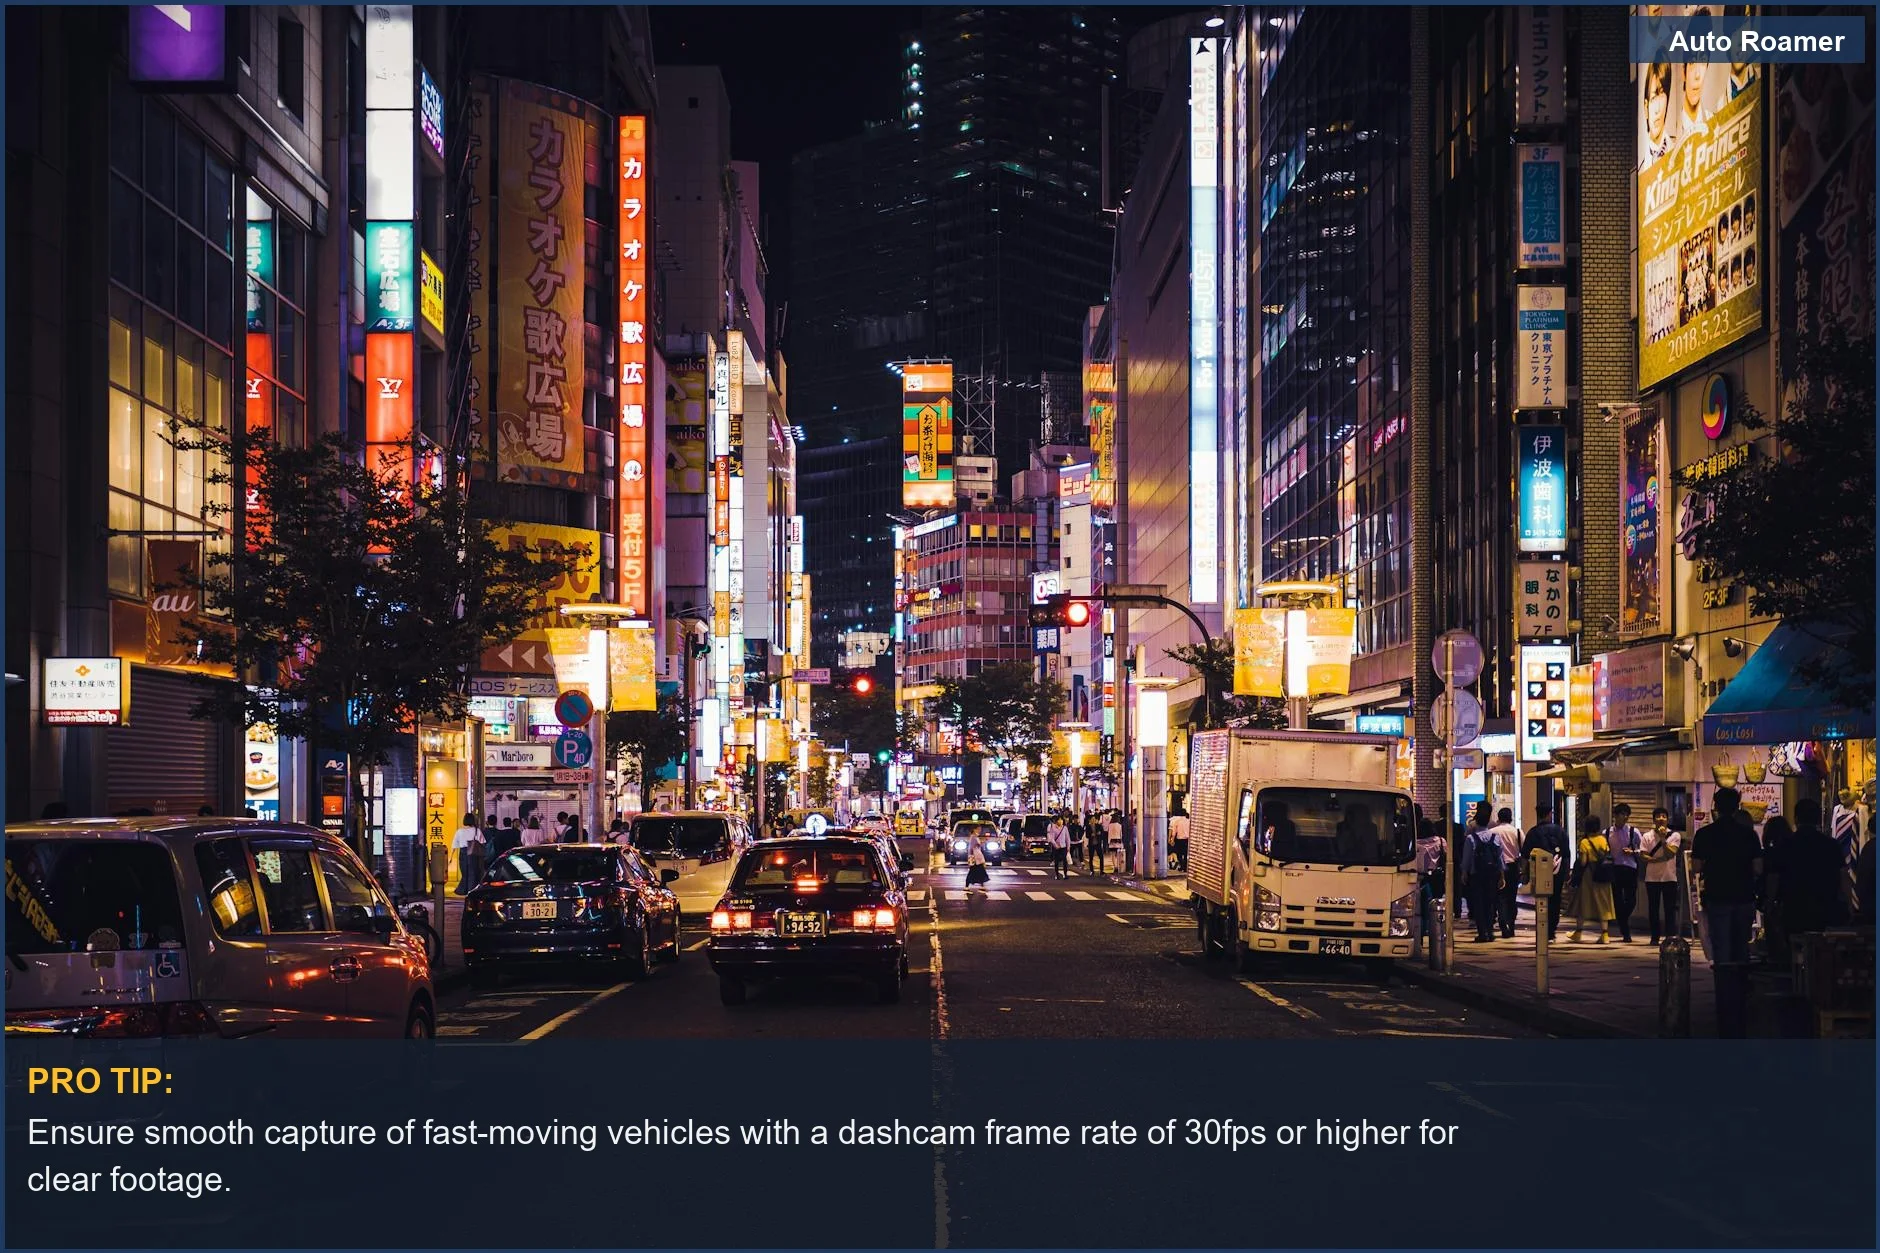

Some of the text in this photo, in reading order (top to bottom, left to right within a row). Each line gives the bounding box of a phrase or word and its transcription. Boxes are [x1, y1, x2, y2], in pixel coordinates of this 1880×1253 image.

[1533, 148, 1549, 160] 3F
[1644, 168, 1681, 217] King
[1694, 114, 1751, 178] Prince
[1526, 166, 1540, 241] クリニック
[1653, 166, 1747, 250] シンデレラガール
[524, 117, 566, 462] カラオケ歌広場
[622, 157, 644, 428] カラオケ歌広場
[1668, 309, 1729, 363] 2018.5.23
[676, 359, 704, 371] aiko
[1531, 332, 1540, 386] クリニック
[1542, 332, 1553, 405] 東京プラチナム
[676, 426, 704, 438] aiko
[1533, 435, 1552, 524] 伊波歯科
[152, 592, 195, 612] au
[1525, 580, 1539, 617] 眼科
[1546, 568, 1560, 619] なかの
[1533, 625, 1553, 635] 7F
[501, 750, 534, 762] Marlboro
[563, 740, 585, 764] P 40
[530, 908, 554, 917] 30-21
[1316, 897, 1356, 906] ISUZU
[791, 922, 820, 933] 94-92
[1325, 944, 1351, 955] 66-40
